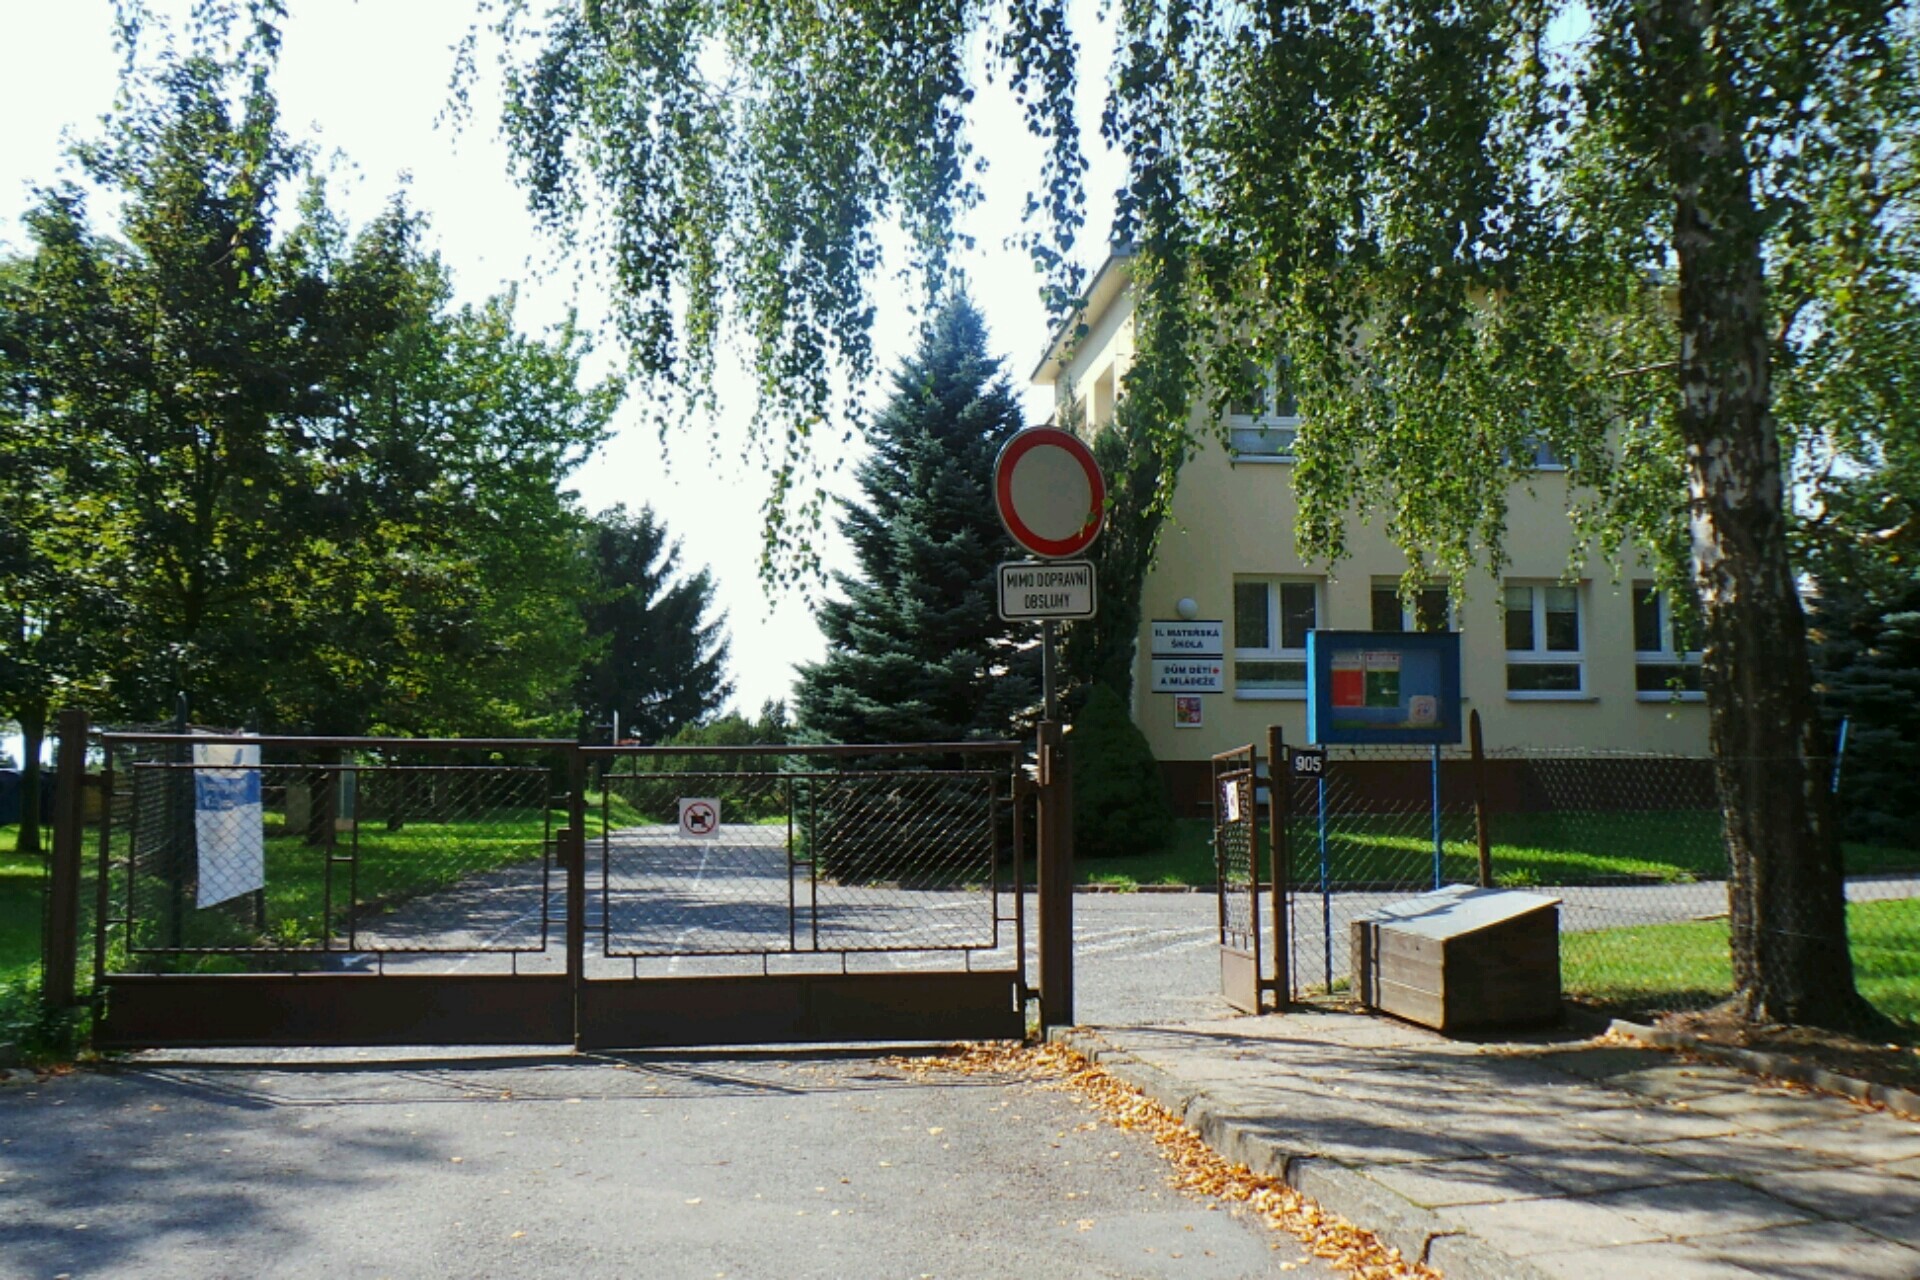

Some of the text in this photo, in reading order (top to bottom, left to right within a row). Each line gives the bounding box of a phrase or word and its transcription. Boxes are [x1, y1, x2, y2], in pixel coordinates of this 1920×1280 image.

[1007, 568, 1087, 588] MIMO DOPRAVNÍ
[1024, 593, 1070, 609] OBSLUHY
[1167, 627, 1219, 637] MATEŘSKÁ
[1171, 639, 1203, 649] ŠKOLA
[1164, 664, 1186, 674] DŮM
[1160, 677, 1167, 685] A
[1295, 756, 1322, 772] 905
